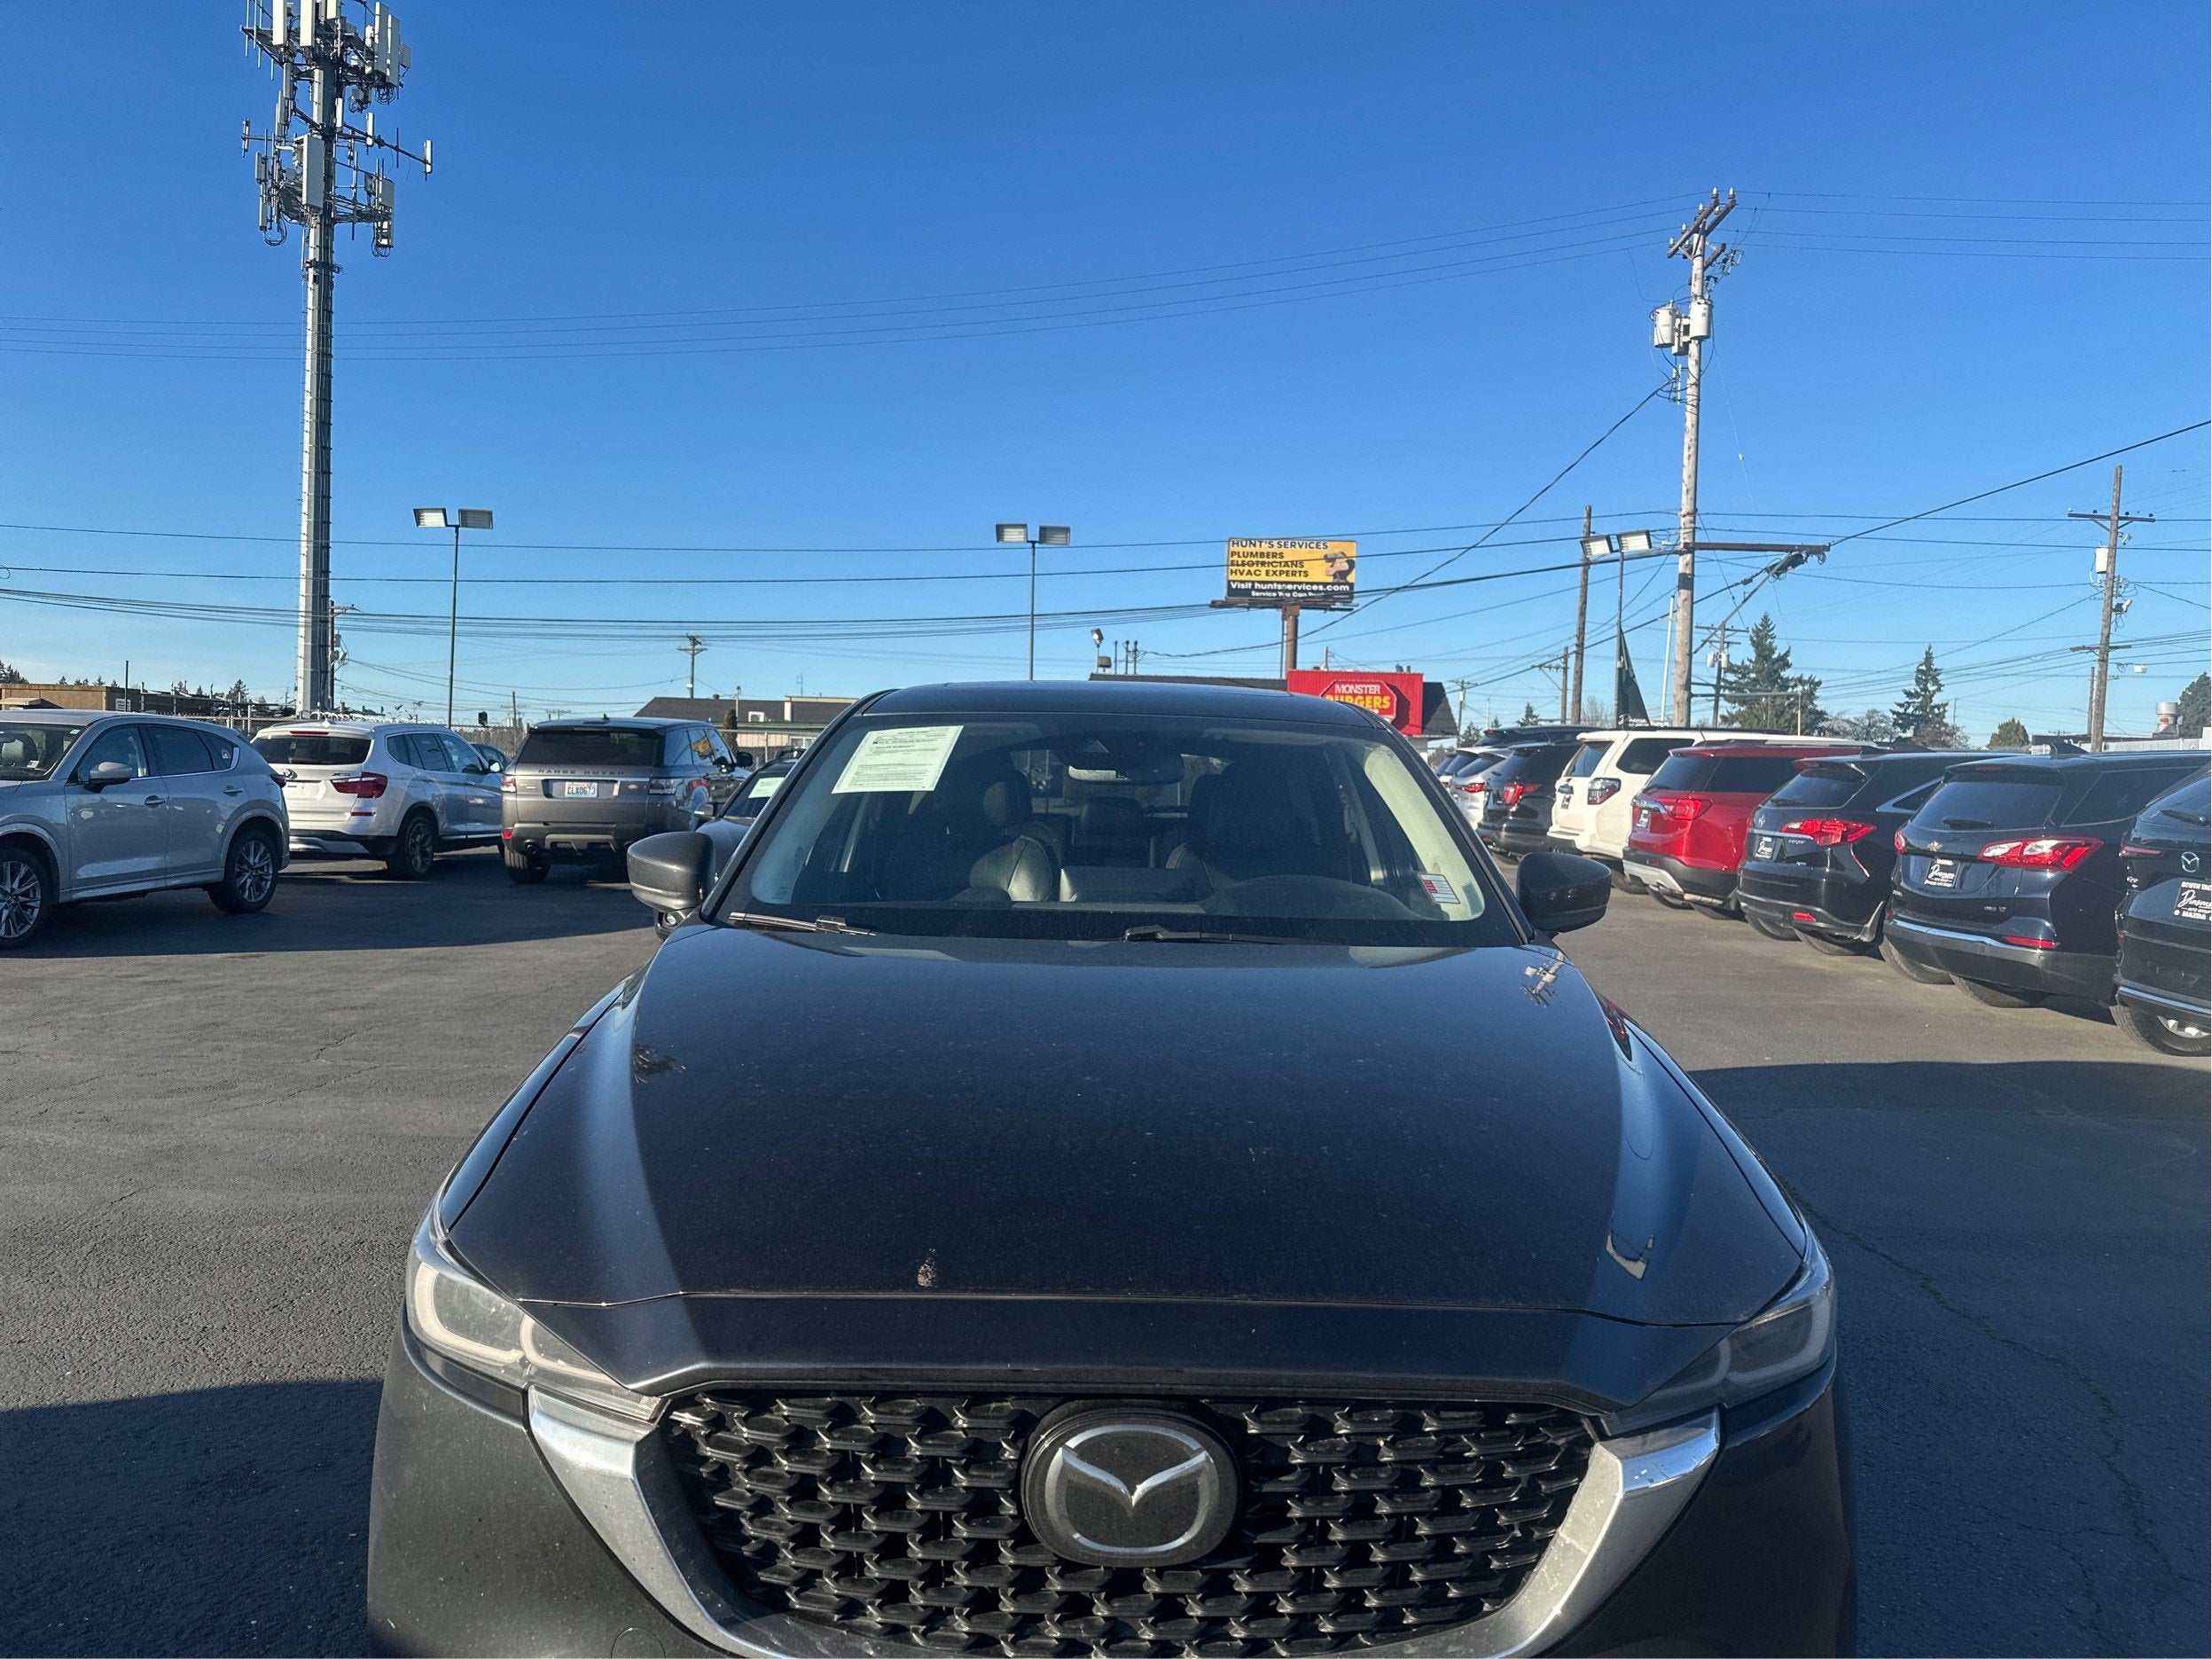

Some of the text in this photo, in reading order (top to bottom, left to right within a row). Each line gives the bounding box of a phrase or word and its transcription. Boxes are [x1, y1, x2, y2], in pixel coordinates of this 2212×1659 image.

[1230, 560, 1305, 568] ELECTRICIANS
[1255, 583, 1349, 591] huntsservices.com
[1335, 684, 1380, 694] MONSTER
